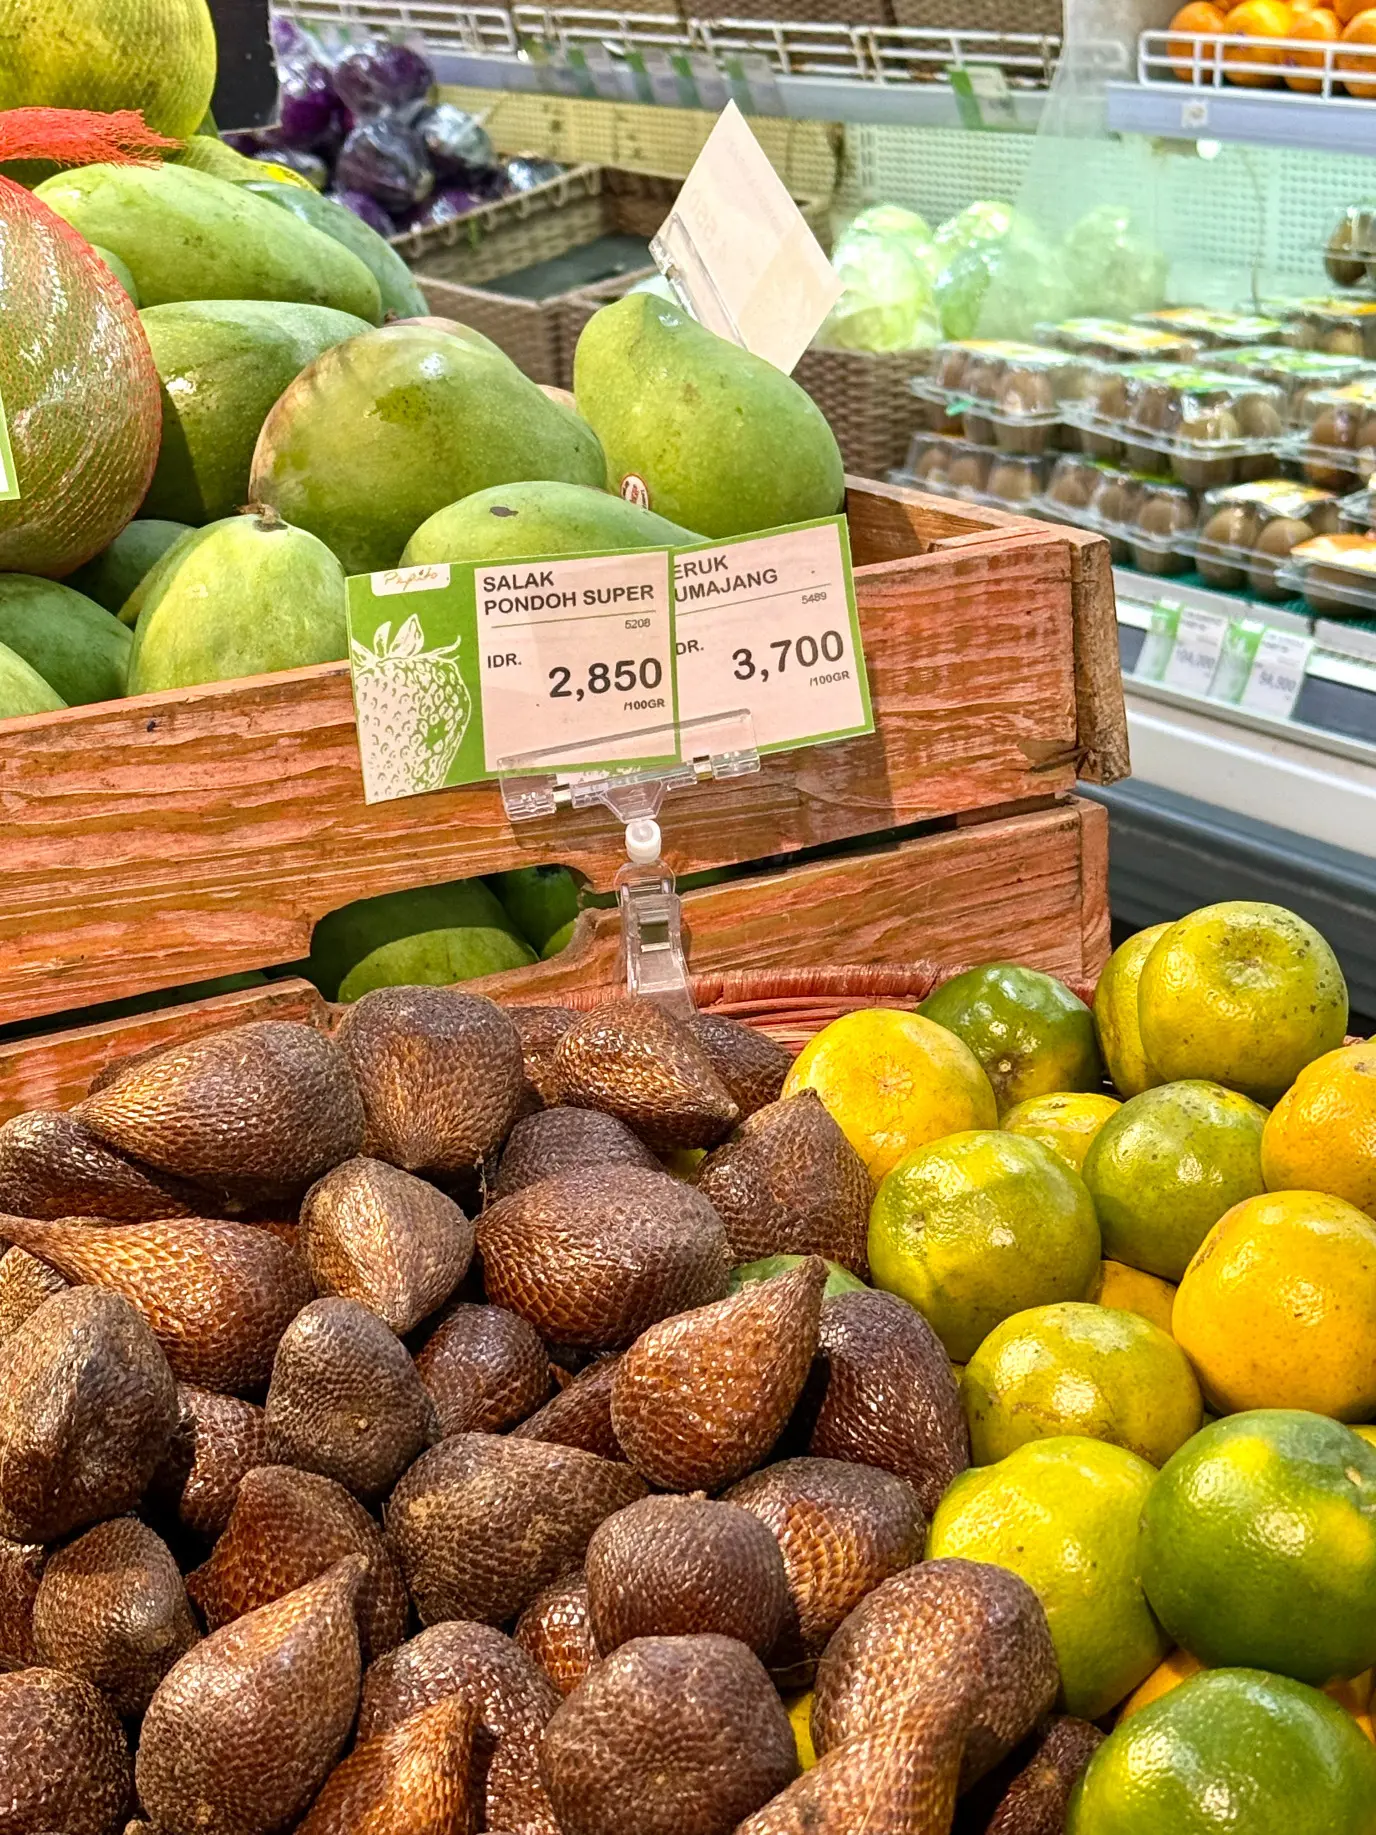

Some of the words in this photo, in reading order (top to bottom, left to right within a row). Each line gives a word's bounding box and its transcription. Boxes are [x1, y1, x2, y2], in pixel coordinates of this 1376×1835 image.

[483, 571, 554, 592] SALAK
[484, 591, 576, 615] PONDOH
[583, 584, 654, 606] SUPER
[801, 592, 827, 604] 5489
[625, 618, 651, 629] 5208
[487, 653, 522, 669] IDR.
[732, 630, 844, 682] 3,700
[549, 657, 662, 702] 2,850
[809, 670, 850, 687] /100GR
[623, 698, 665, 711] /100GR
